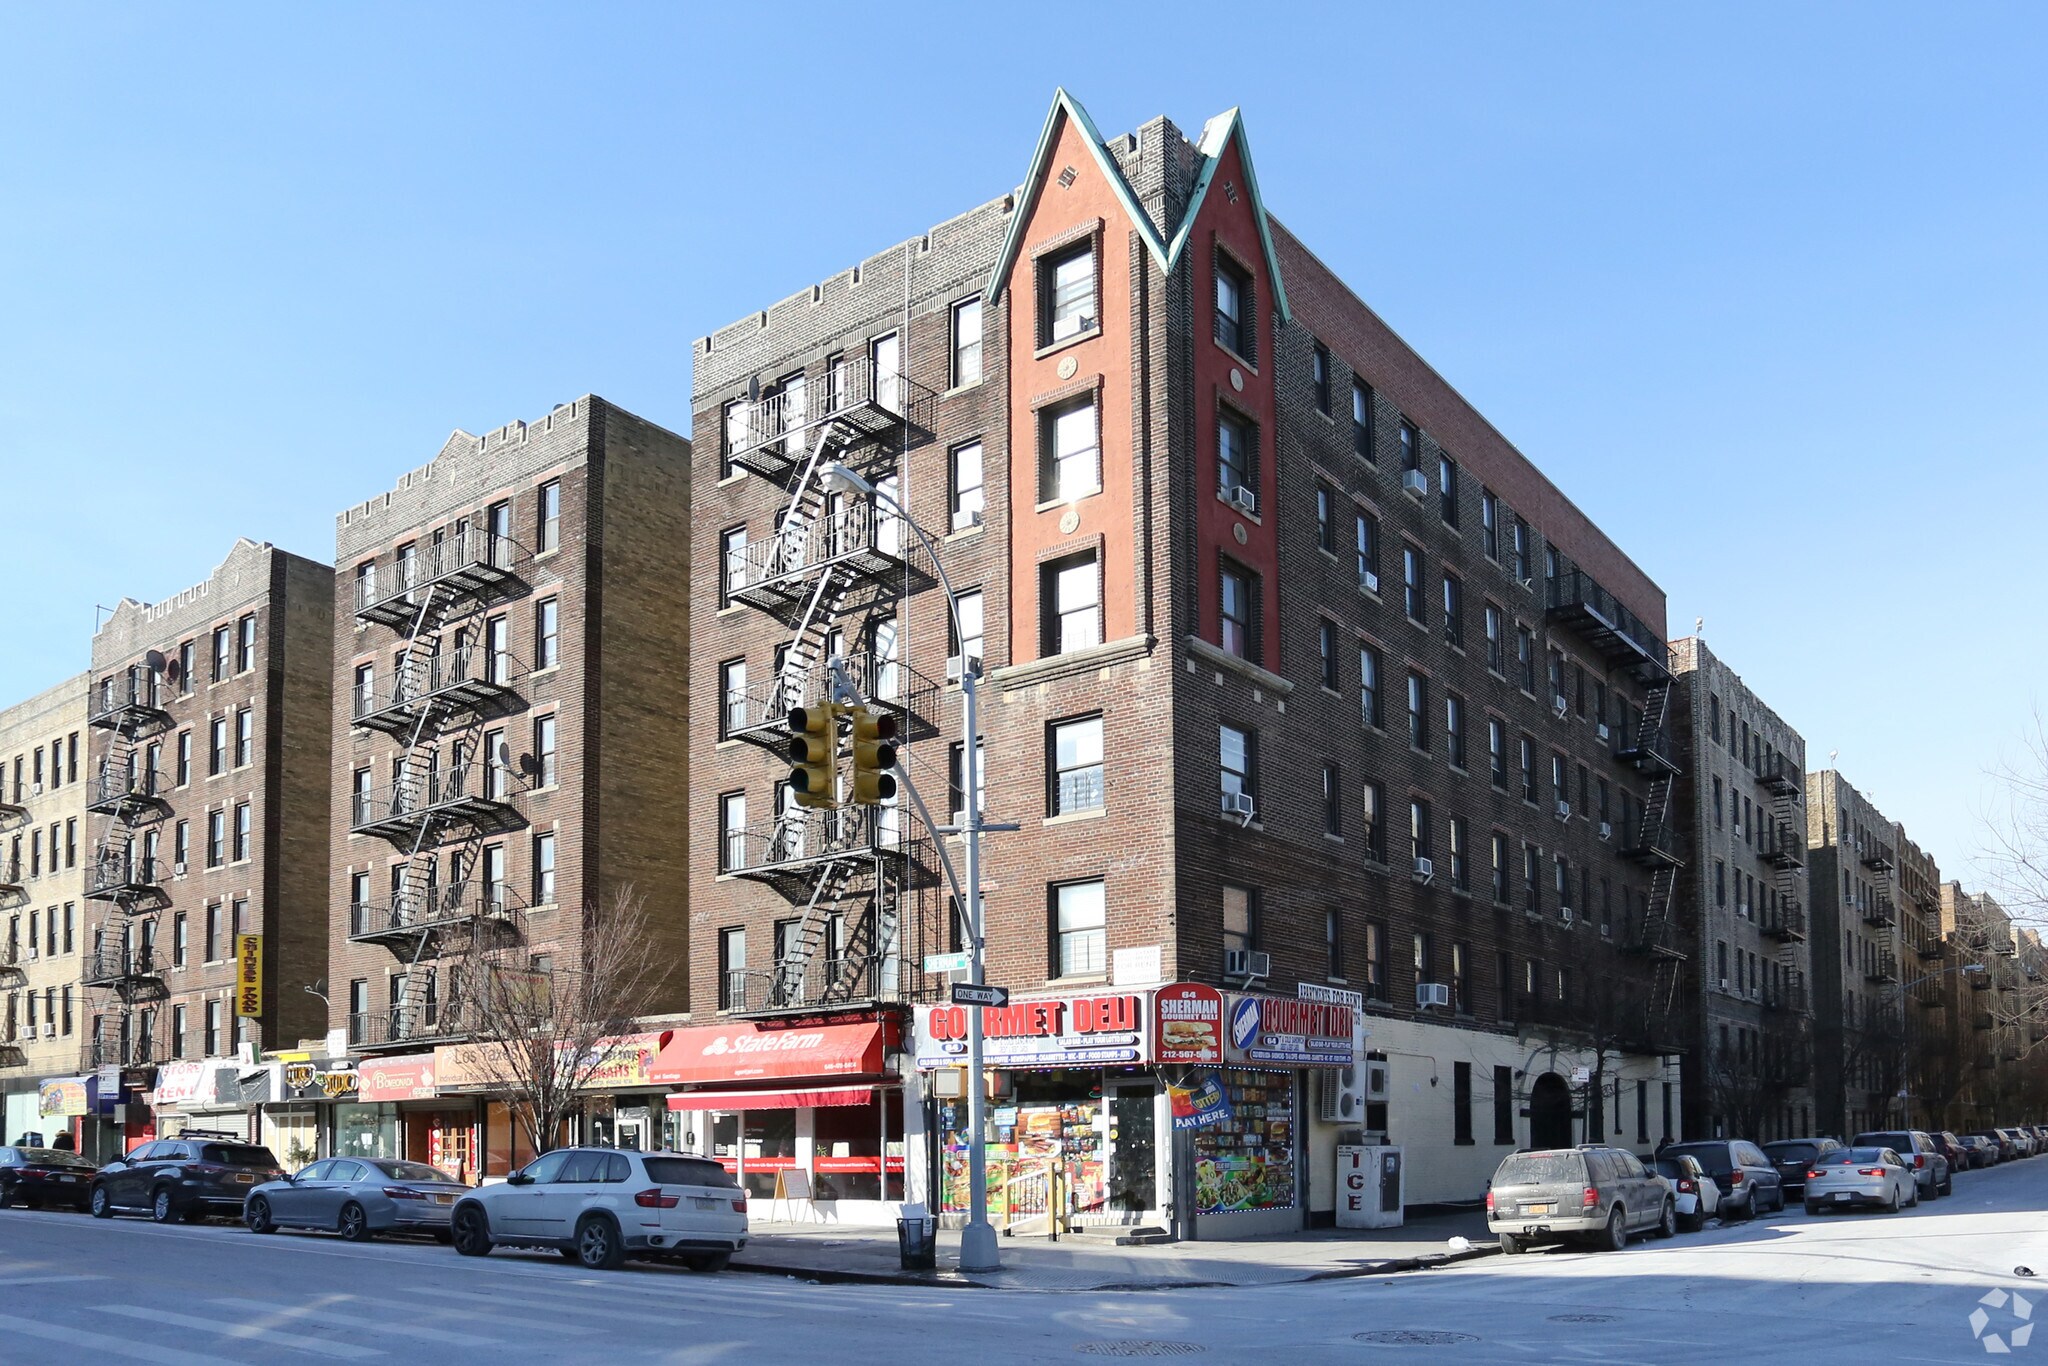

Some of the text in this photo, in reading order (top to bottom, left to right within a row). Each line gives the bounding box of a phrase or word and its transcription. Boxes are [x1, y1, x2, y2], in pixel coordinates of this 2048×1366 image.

[242, 987, 258, 1013] FOOD
[957, 989, 993, 1001] ONE WAY
[1181, 991, 1197, 999] 64
[1160, 999, 1218, 1014] SHERMAN
[929, 996, 1135, 1040] GORMET DELI
[1263, 998, 1323, 1036] GOURMET
[1266, 1037, 1277, 1045] 64
[1162, 1050, 1218, 1059] 212-567-55
[1175, 1109, 1228, 1128] PLAY HERE.
[1347, 1152, 1364, 1210] ICE
